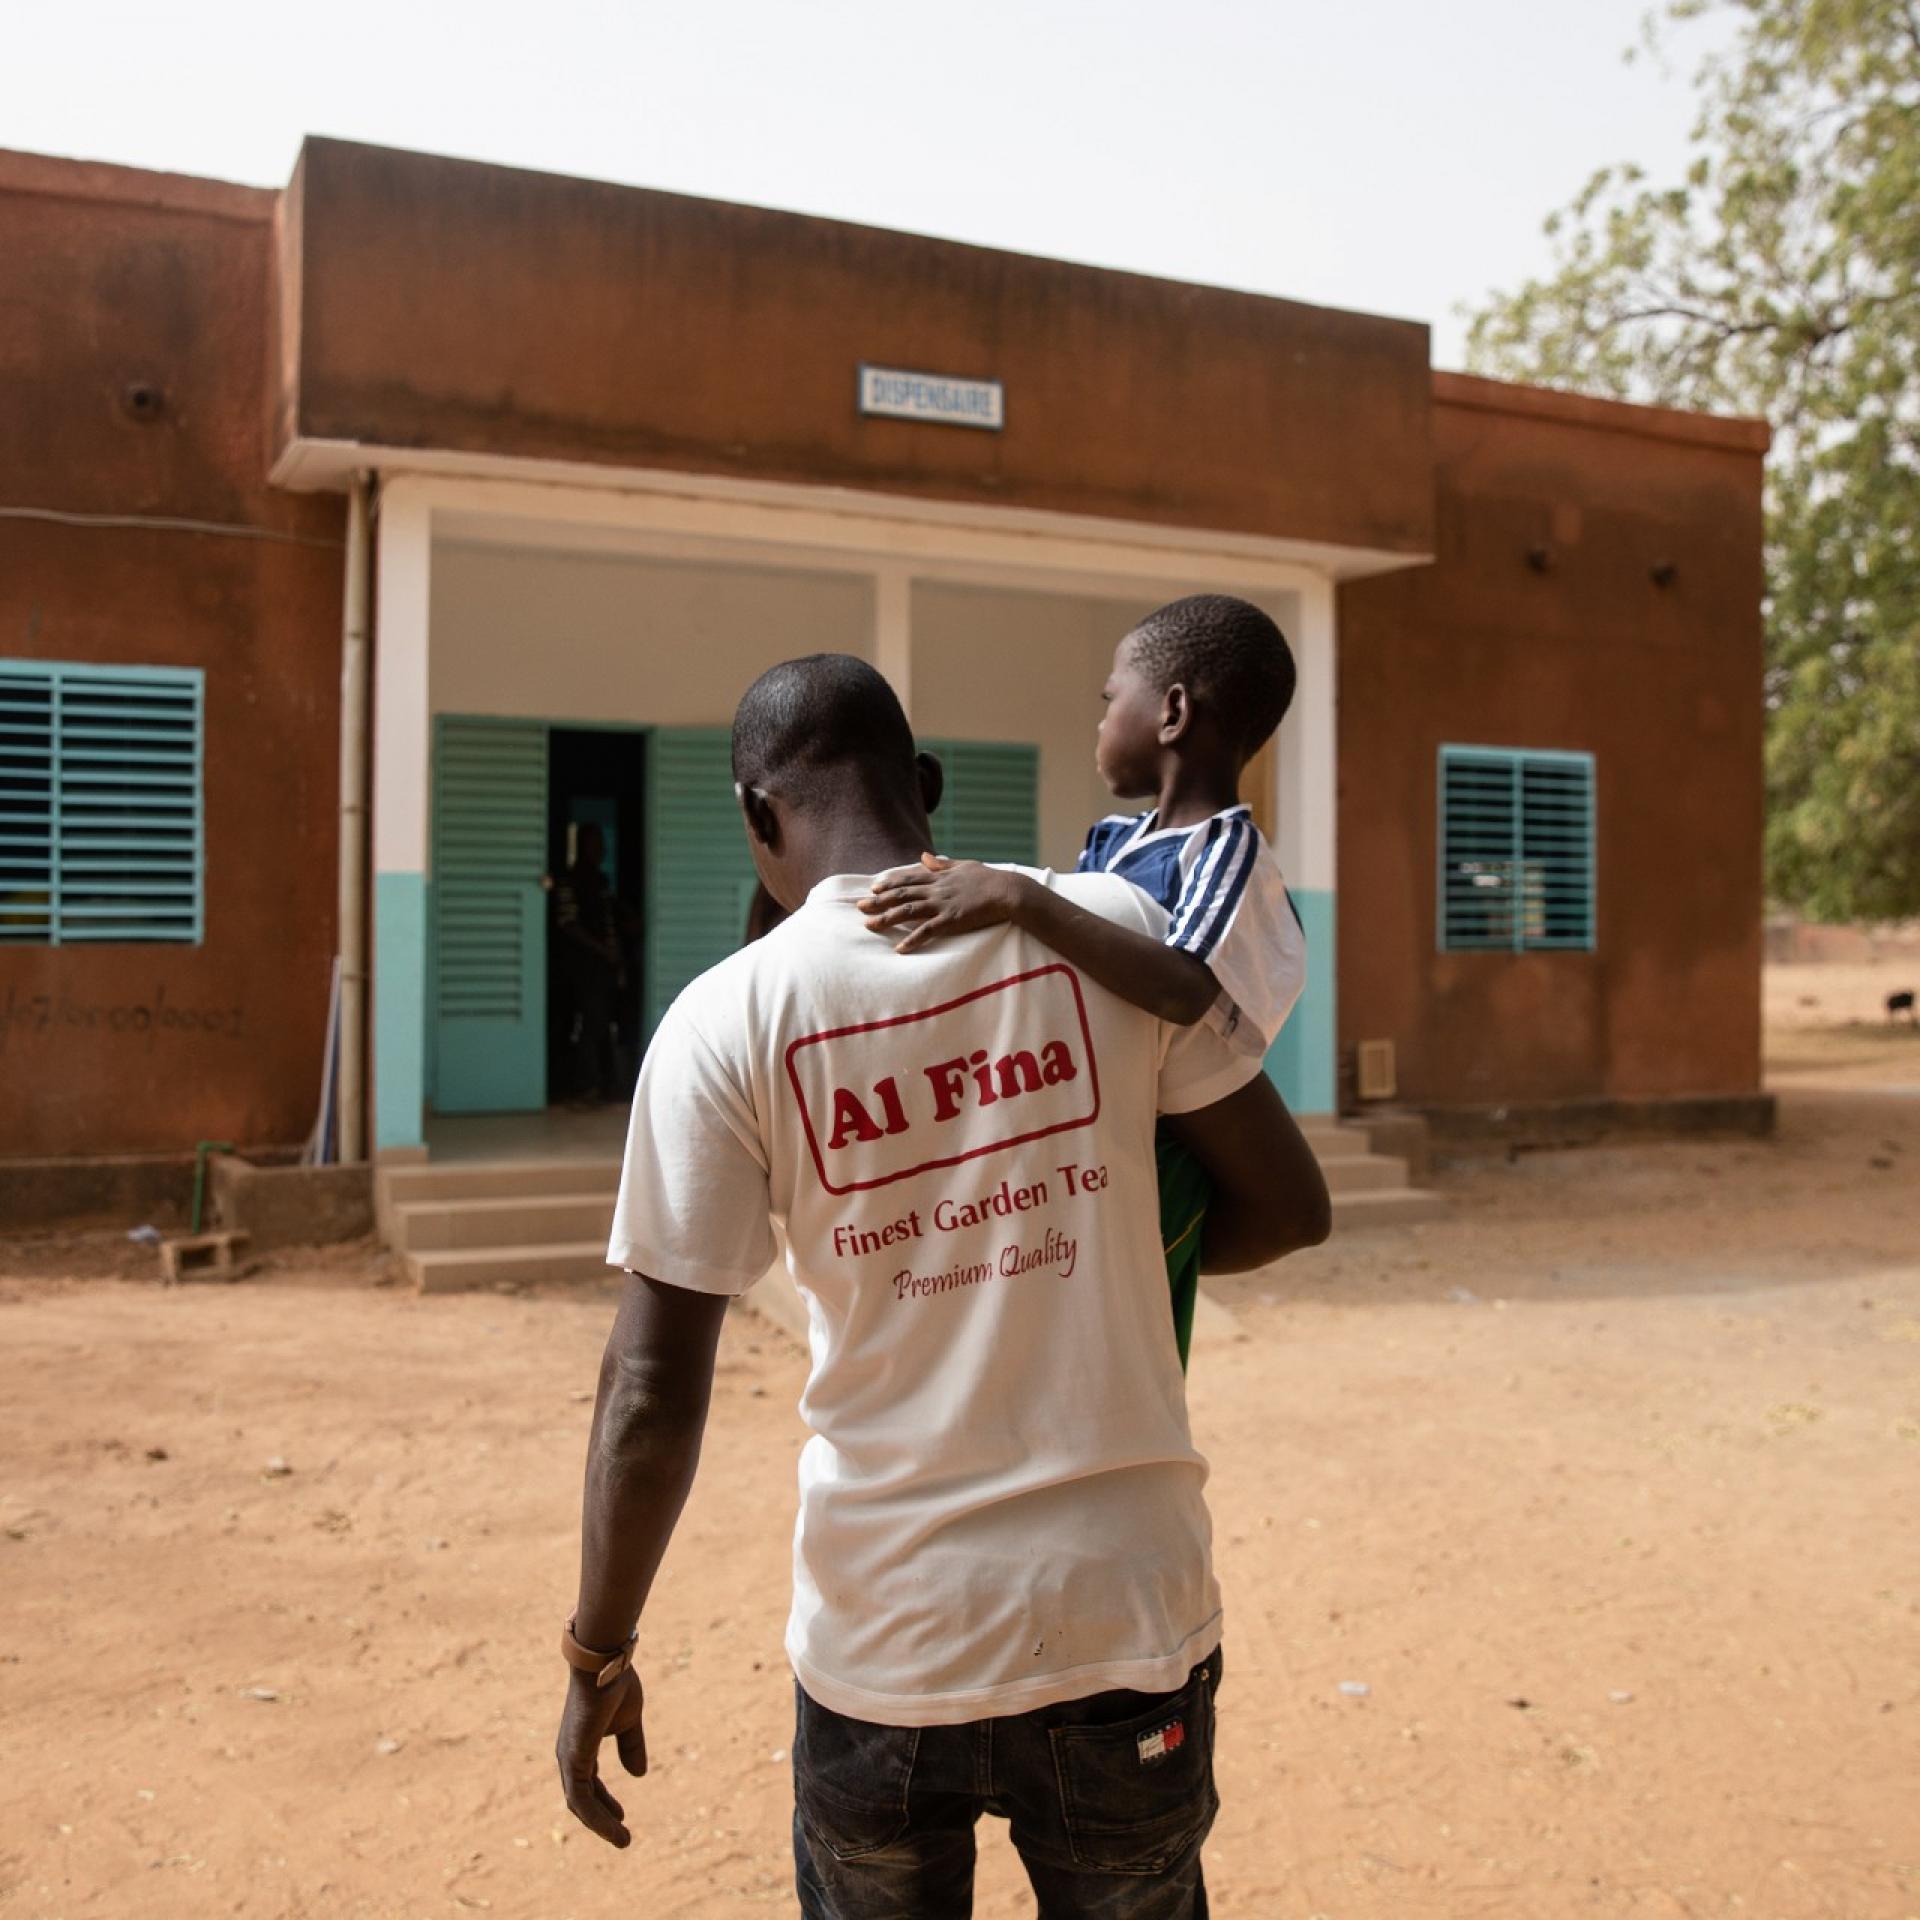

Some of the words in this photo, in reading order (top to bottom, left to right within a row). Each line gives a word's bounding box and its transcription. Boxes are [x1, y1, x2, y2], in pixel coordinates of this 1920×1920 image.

[827, 1076, 909, 1150] Al
[923, 1040, 1078, 1123] Fina
[832, 1211, 924, 1257] Finest
[933, 1182, 1048, 1231] Garden
[1056, 1163, 1109, 1197] Tea
[893, 1262, 993, 1300] Premium
[999, 1227, 1078, 1278] Quality
